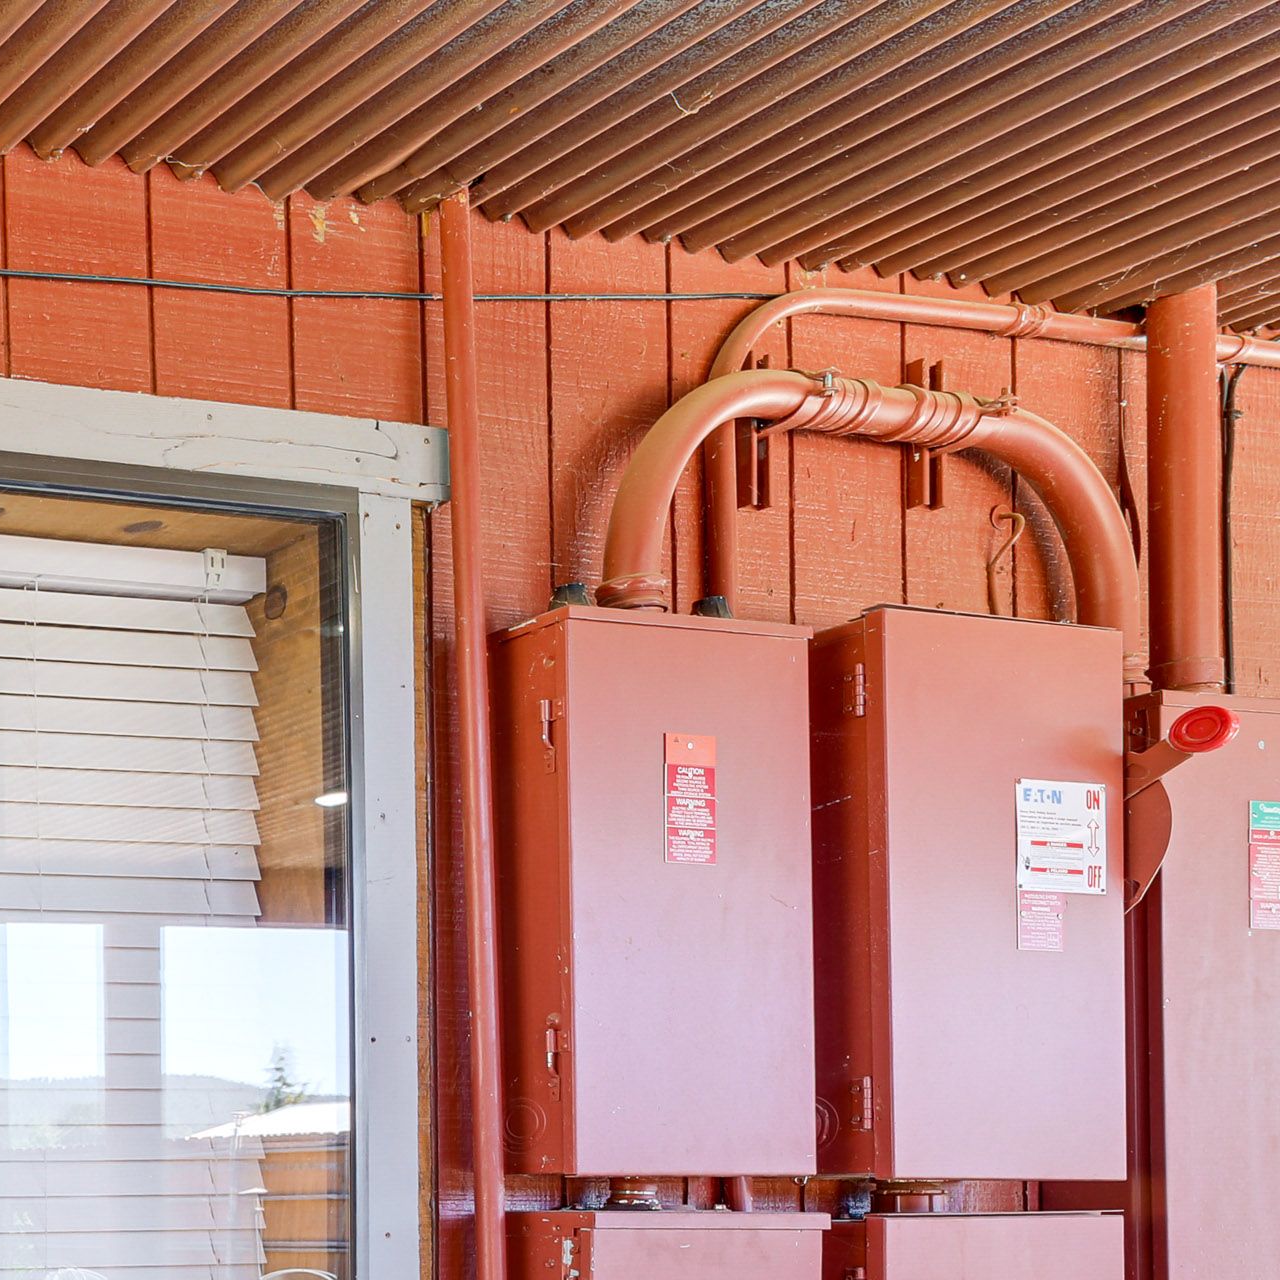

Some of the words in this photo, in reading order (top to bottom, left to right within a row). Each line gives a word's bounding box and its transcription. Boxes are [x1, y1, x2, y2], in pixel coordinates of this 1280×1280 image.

[676, 798, 705, 807] WARNING
[1086, 789, 1101, 810] ON
[1087, 865, 1102, 889] OFF
